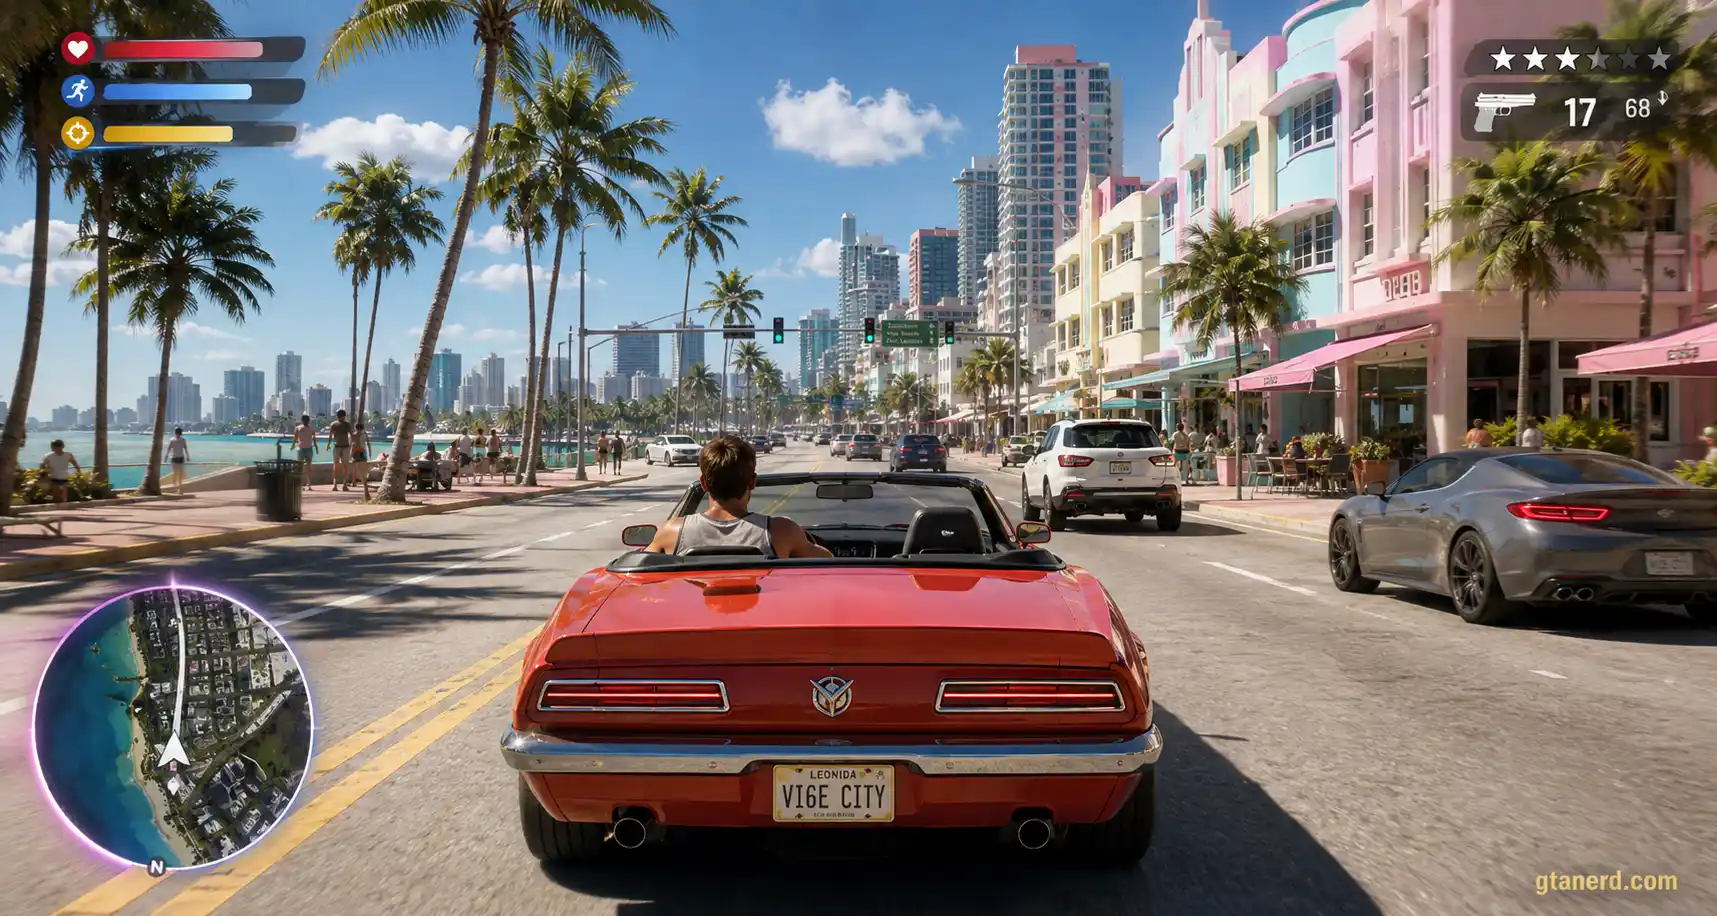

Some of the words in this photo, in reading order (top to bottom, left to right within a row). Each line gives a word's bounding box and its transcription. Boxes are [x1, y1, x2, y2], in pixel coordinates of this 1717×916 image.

[810, 770, 857, 779] LEONIDA
[782, 784, 829, 809] VI6E
[841, 784, 886, 809] CITY
